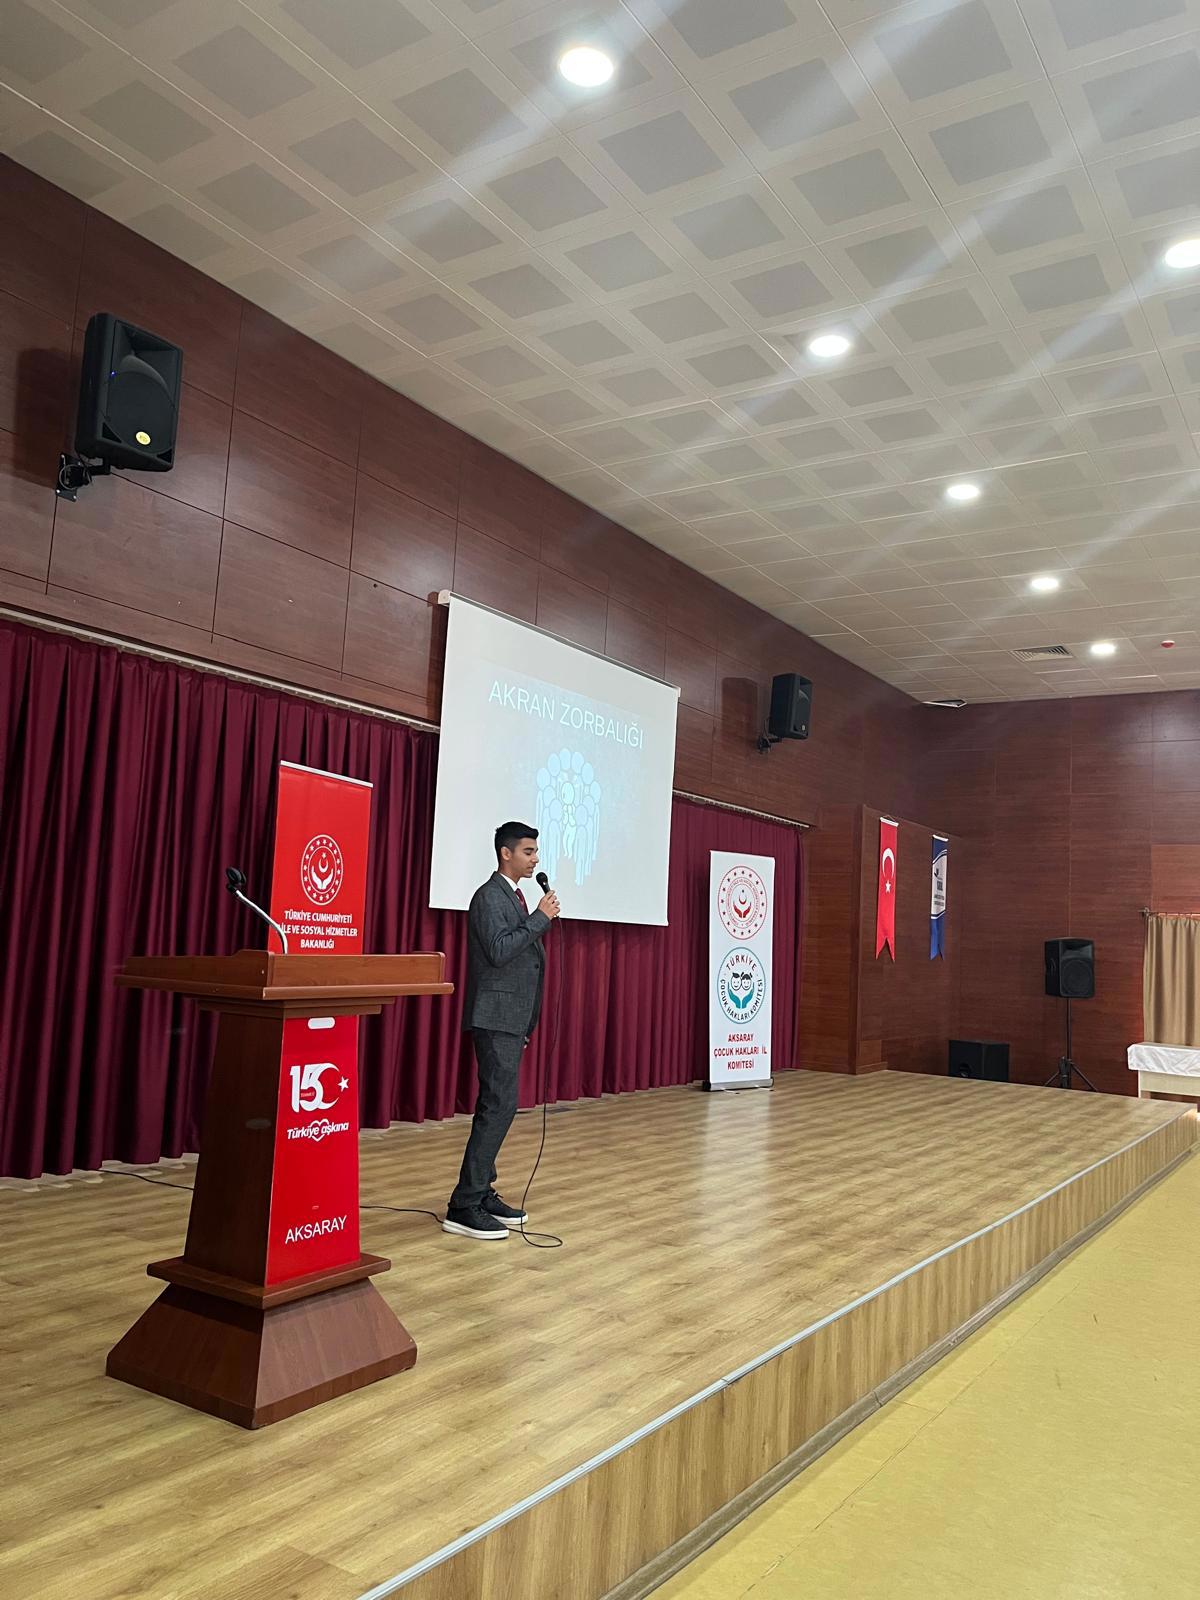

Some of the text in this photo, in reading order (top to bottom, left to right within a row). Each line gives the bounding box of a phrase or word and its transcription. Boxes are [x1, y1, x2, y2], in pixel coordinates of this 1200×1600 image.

[489, 680, 643, 749] AKRAN ZORBALIĞI
[284, 909, 353, 924] TÜRKİYE CUMHURİYETİ
[278, 922, 358, 937] İLE VE SOSYAL HİZMETLER
[300, 938, 335, 949] BAKANLIĞI
[728, 1033, 754, 1042] AKSARAY
[714, 1047, 733, 1058] ÇOCUK
[735, 1046, 759, 1056] HAKLARI
[290, 1063, 325, 1113] 15
[287, 1121, 349, 1139] Türkiye aşkına
[285, 1215, 347, 1244] AKSARAY
